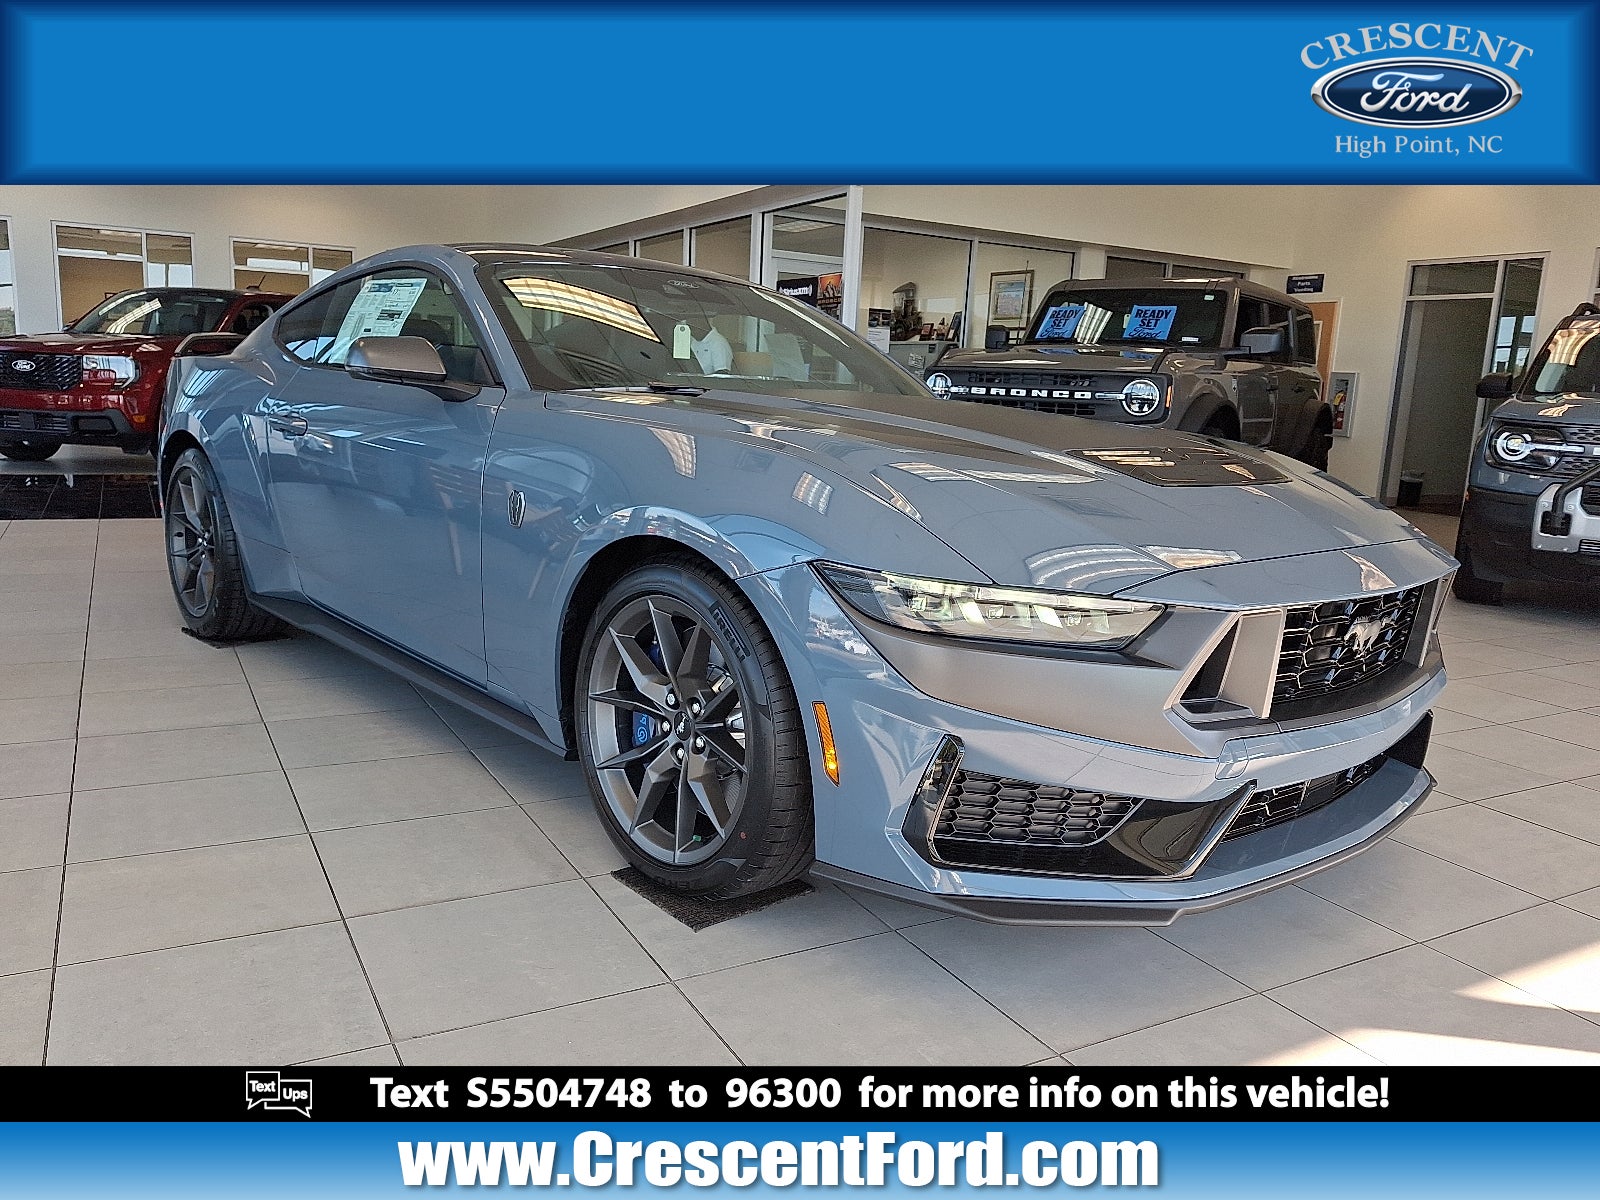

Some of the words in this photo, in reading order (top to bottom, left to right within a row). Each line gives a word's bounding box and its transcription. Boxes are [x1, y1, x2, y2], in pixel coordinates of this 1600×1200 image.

[1049, 309, 1081, 319] READY
[1135, 309, 1171, 319] READY
[1052, 318, 1069, 327] SET
[1139, 318, 1160, 328] SET
[1128, 326, 1162, 339] Ford
[970, 386, 1092, 400] BRONCO
